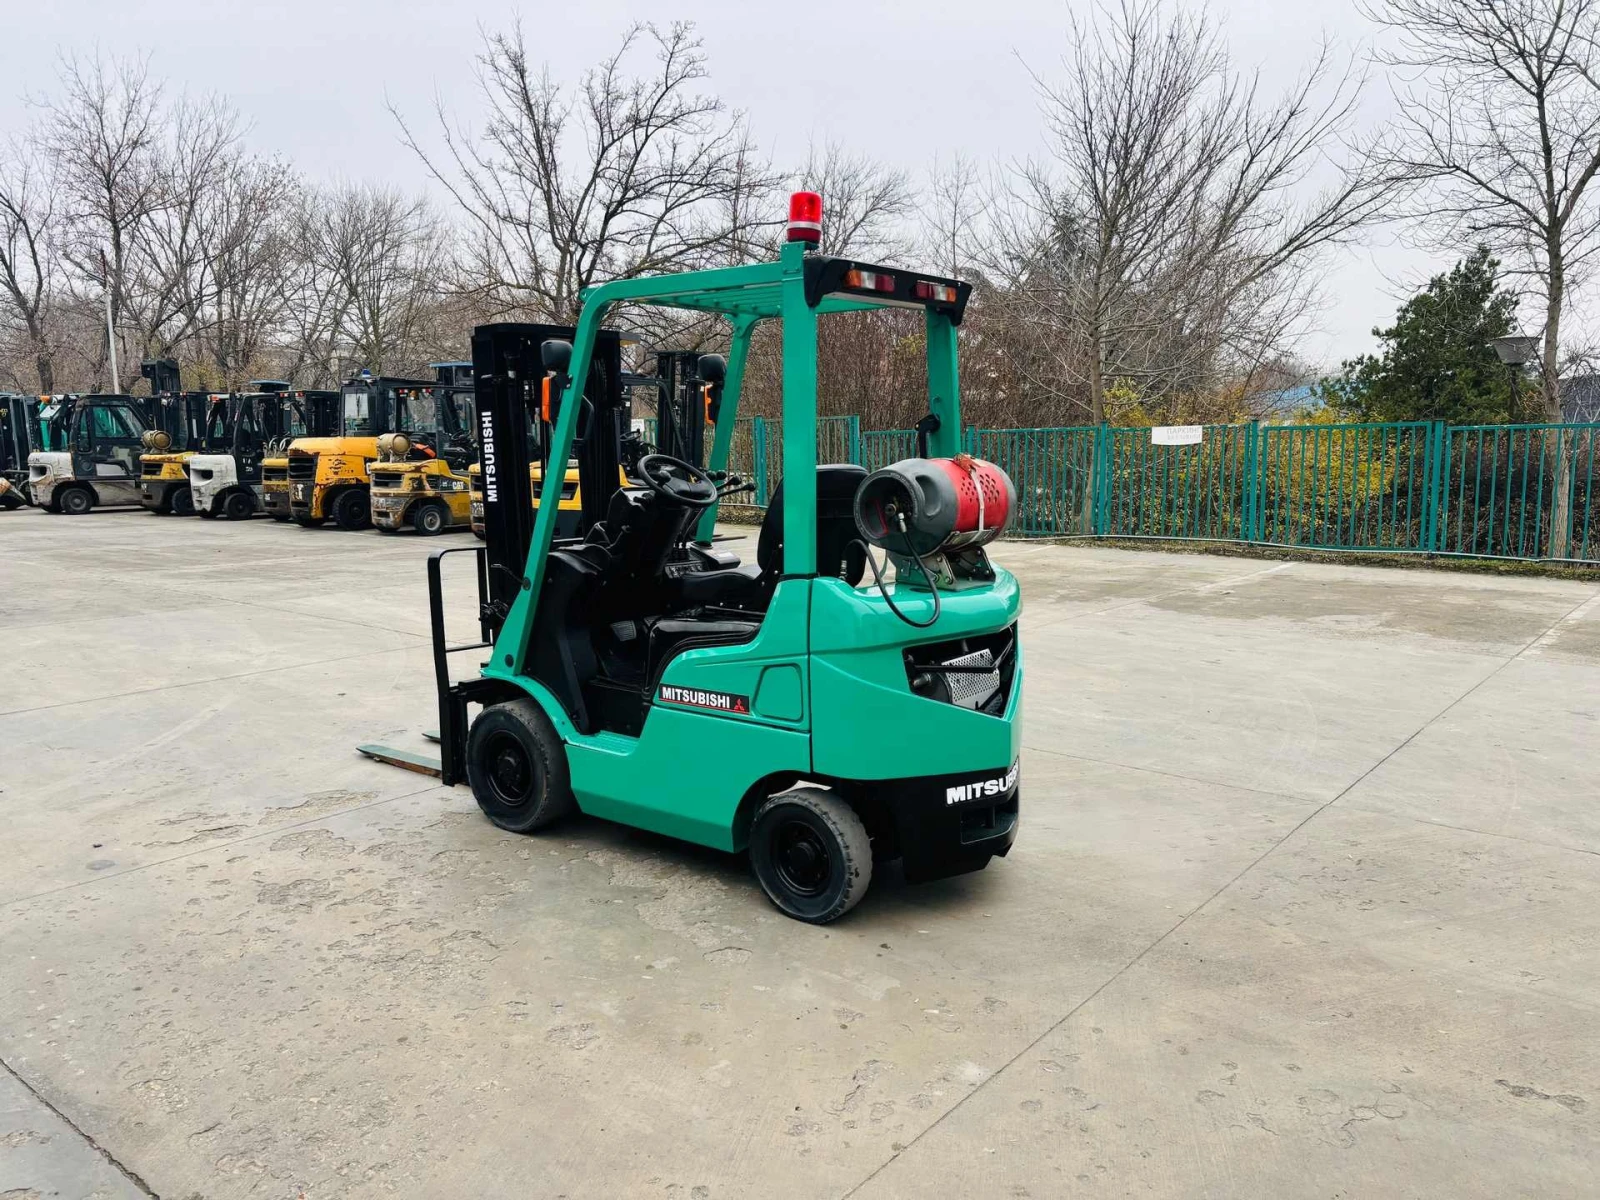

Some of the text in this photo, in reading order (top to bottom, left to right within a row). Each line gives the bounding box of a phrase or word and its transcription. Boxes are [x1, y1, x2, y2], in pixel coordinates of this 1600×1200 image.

[481, 411, 498, 502] MITSUBISHI
[452, 481, 464, 490] CAT
[662, 686, 730, 708] MITSUBISHI
